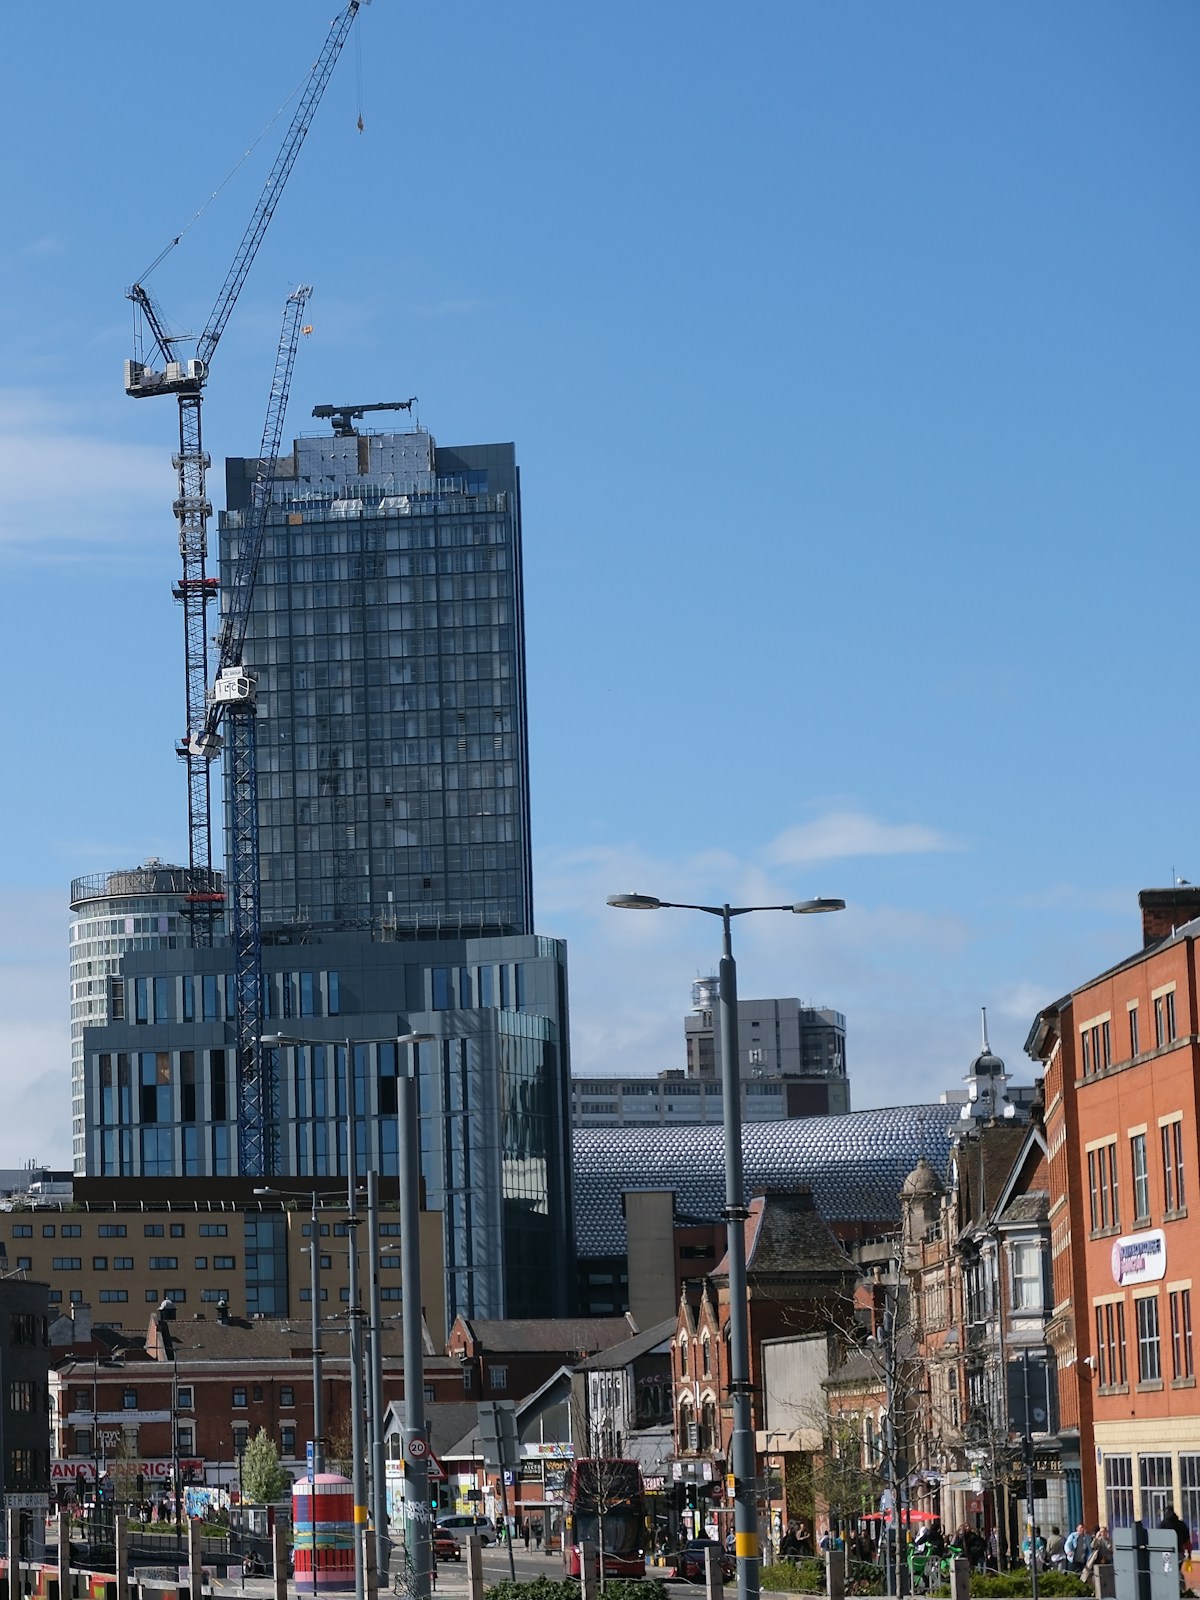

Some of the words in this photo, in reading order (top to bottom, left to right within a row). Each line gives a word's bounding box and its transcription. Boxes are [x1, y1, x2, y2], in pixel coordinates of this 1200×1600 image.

[411, 1444, 424, 1452] 20
[50, 1463, 97, 1477] ANCY
[106, 1462, 175, 1477] FABRICS
